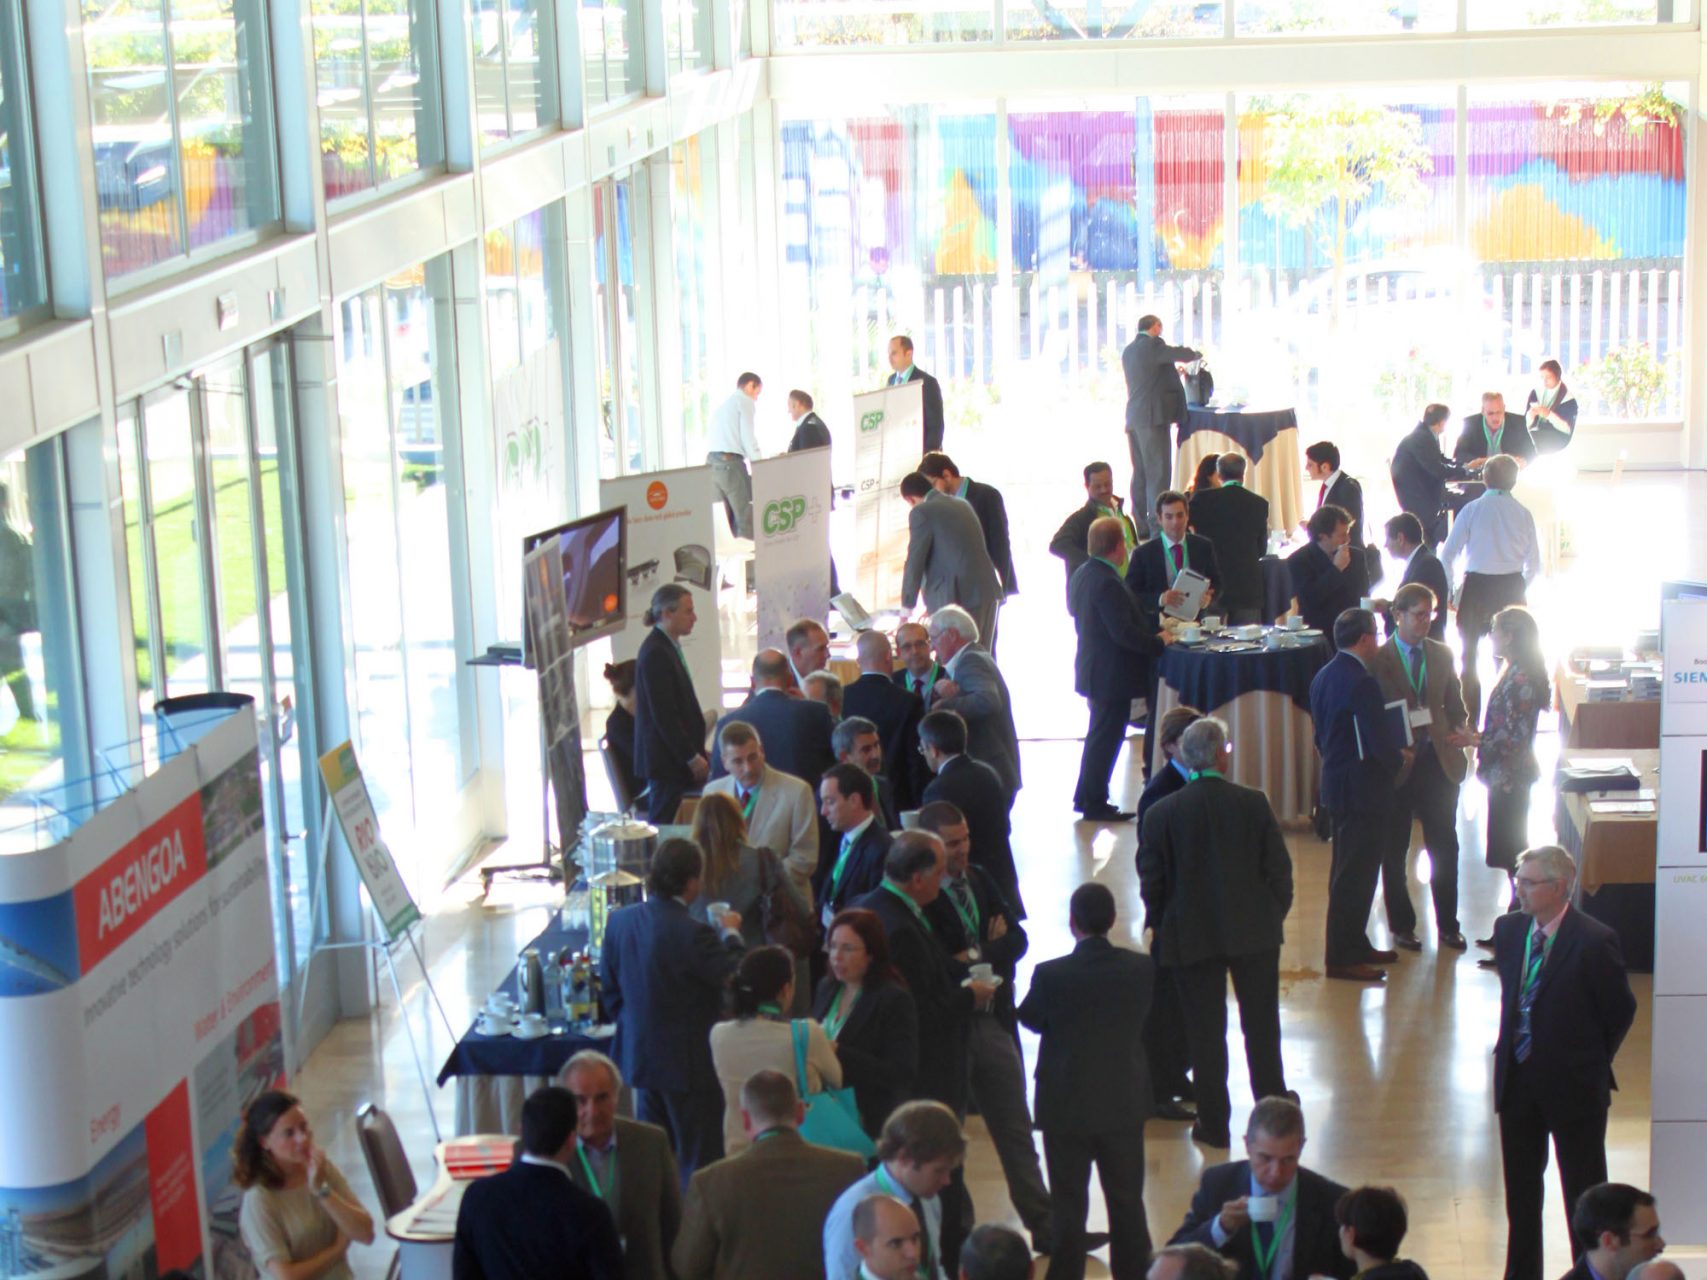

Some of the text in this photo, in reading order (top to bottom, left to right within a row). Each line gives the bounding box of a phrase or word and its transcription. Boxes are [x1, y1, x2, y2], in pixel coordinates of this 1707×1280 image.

[860, 410, 884, 432] CSP
[761, 495, 806, 537] CSP
[98, 829, 186, 940] ABENGOA
